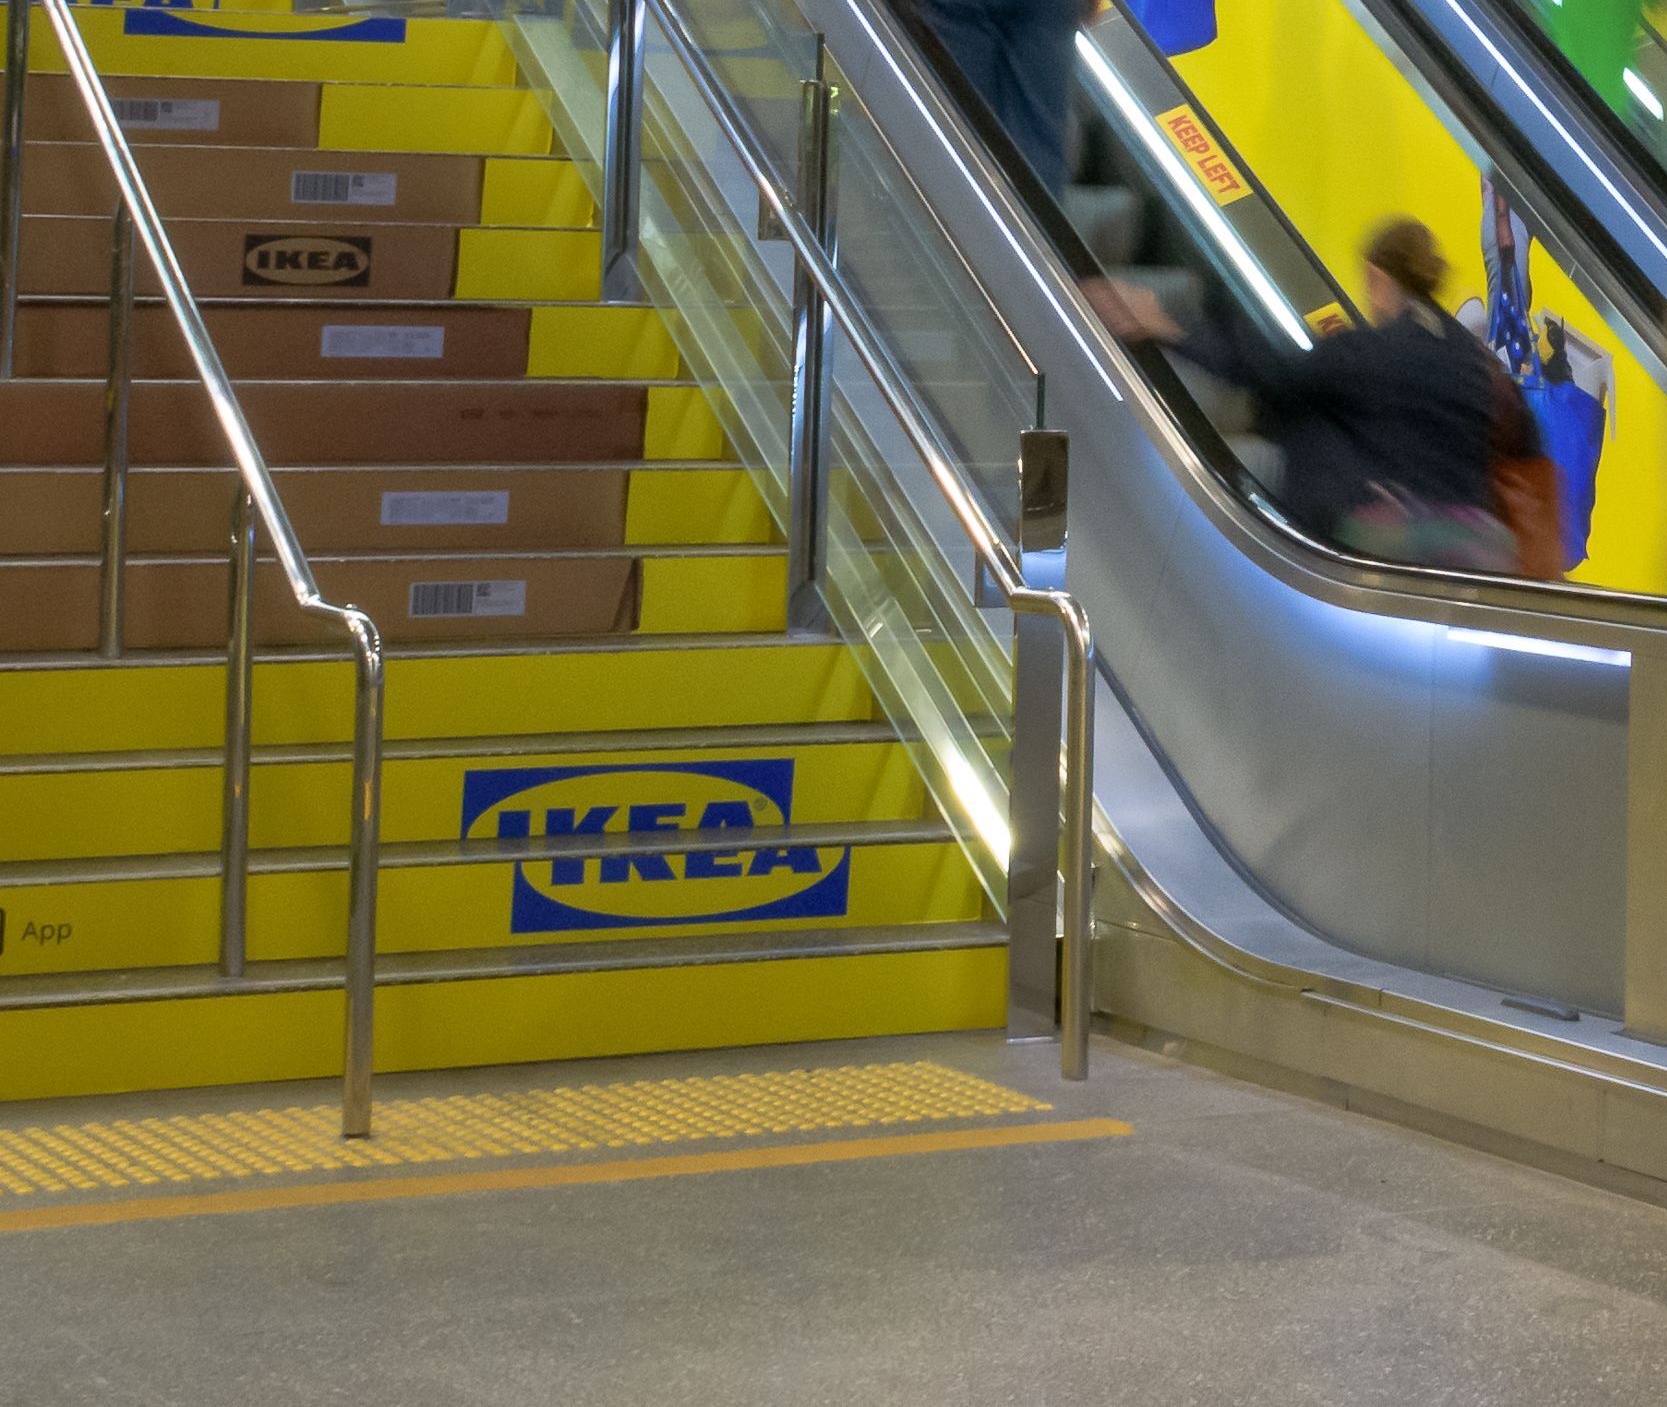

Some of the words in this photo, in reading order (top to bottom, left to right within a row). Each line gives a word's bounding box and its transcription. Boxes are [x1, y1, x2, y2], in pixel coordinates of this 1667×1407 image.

[1167, 114, 1211, 161] KEEP
[1196, 154, 1241, 195] LEFT
[257, 248, 363, 271] IKEA
[497, 799, 823, 887] IKEA
[21, 921, 73, 945] App
